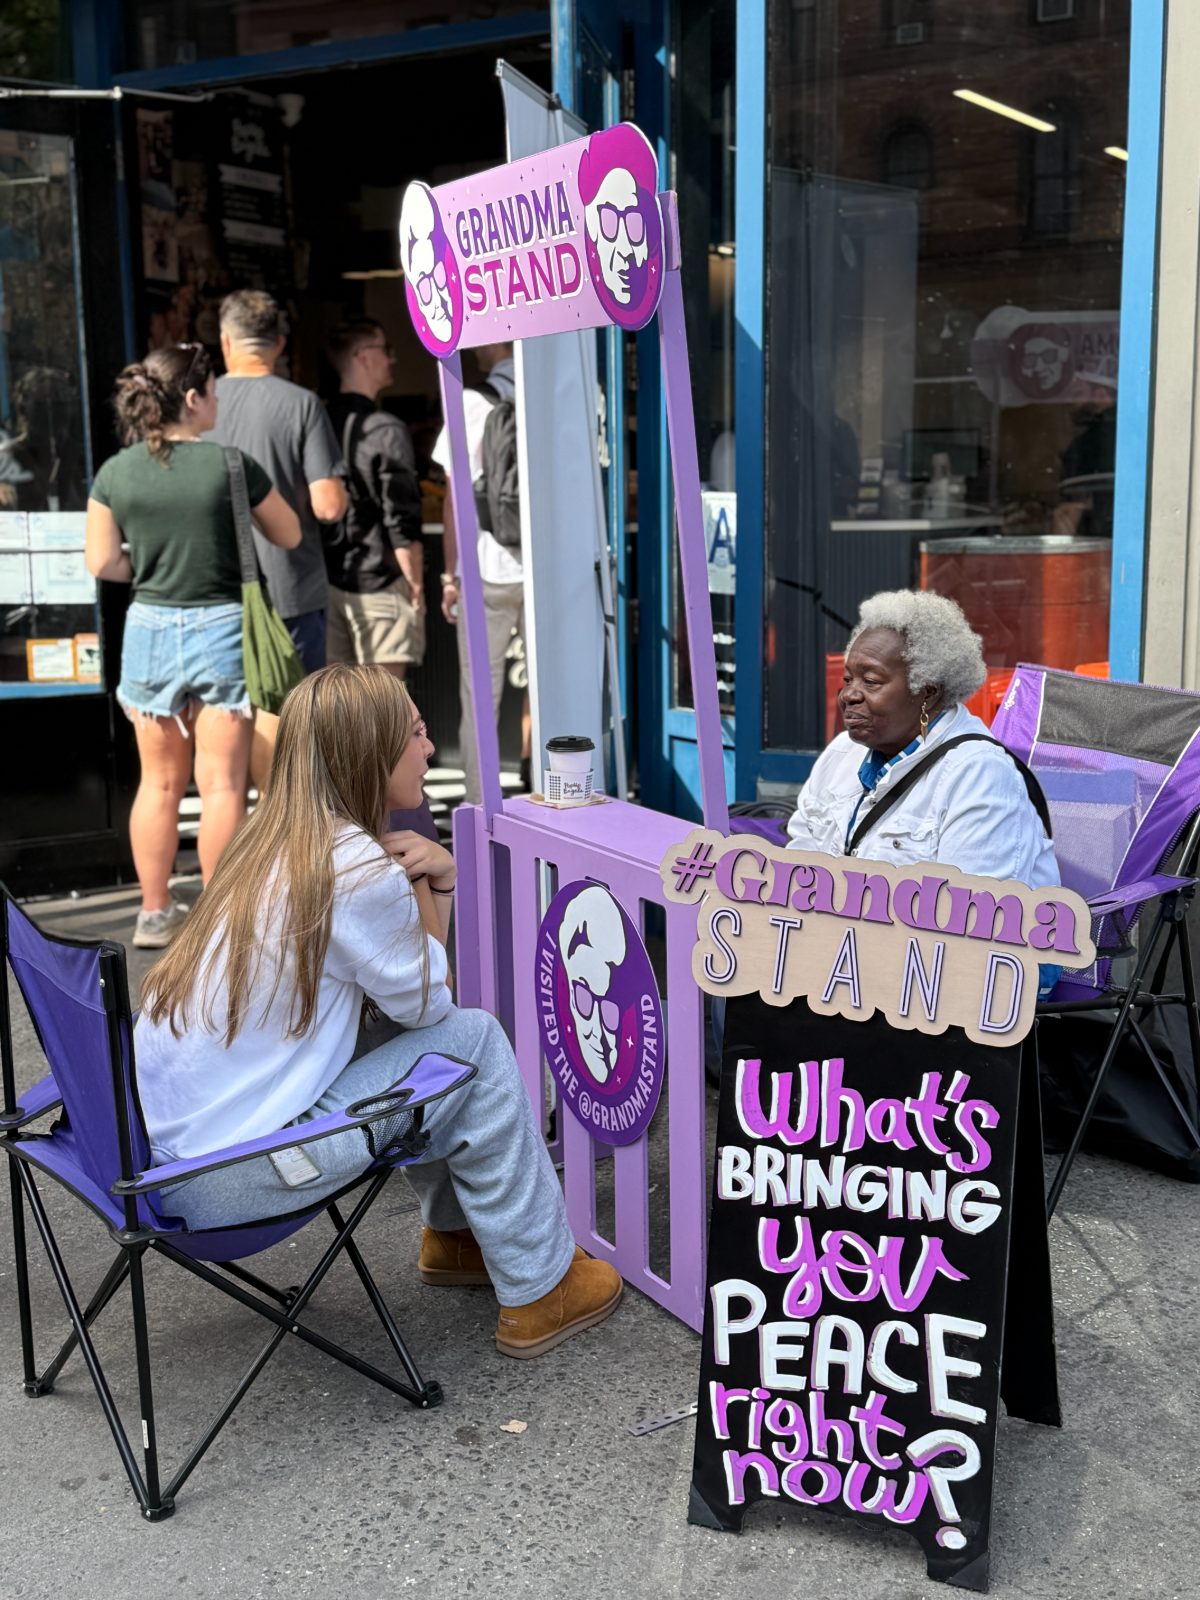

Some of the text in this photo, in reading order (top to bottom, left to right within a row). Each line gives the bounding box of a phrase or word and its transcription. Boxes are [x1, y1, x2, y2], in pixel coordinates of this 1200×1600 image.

[456, 181, 577, 260] GRANDMA
[464, 243, 583, 314] STAND
[708, 507, 736, 565] A
[671, 843, 1080, 954] #Grandma
[703, 907, 1025, 1034] STAND
[540, 949, 560, 1046] VISITED
[554, 1047, 579, 1099] THE
[578, 993, 658, 1132] @GRANDMASTAND
[735, 1057, 1001, 1173] What's
[717, 1145, 1002, 1235] BRINGING
[758, 1215, 970, 1318] you
[710, 1278, 987, 1425] PEACE
[709, 1380, 906, 1470] right
[723, 1429, 982, 1550] now?
